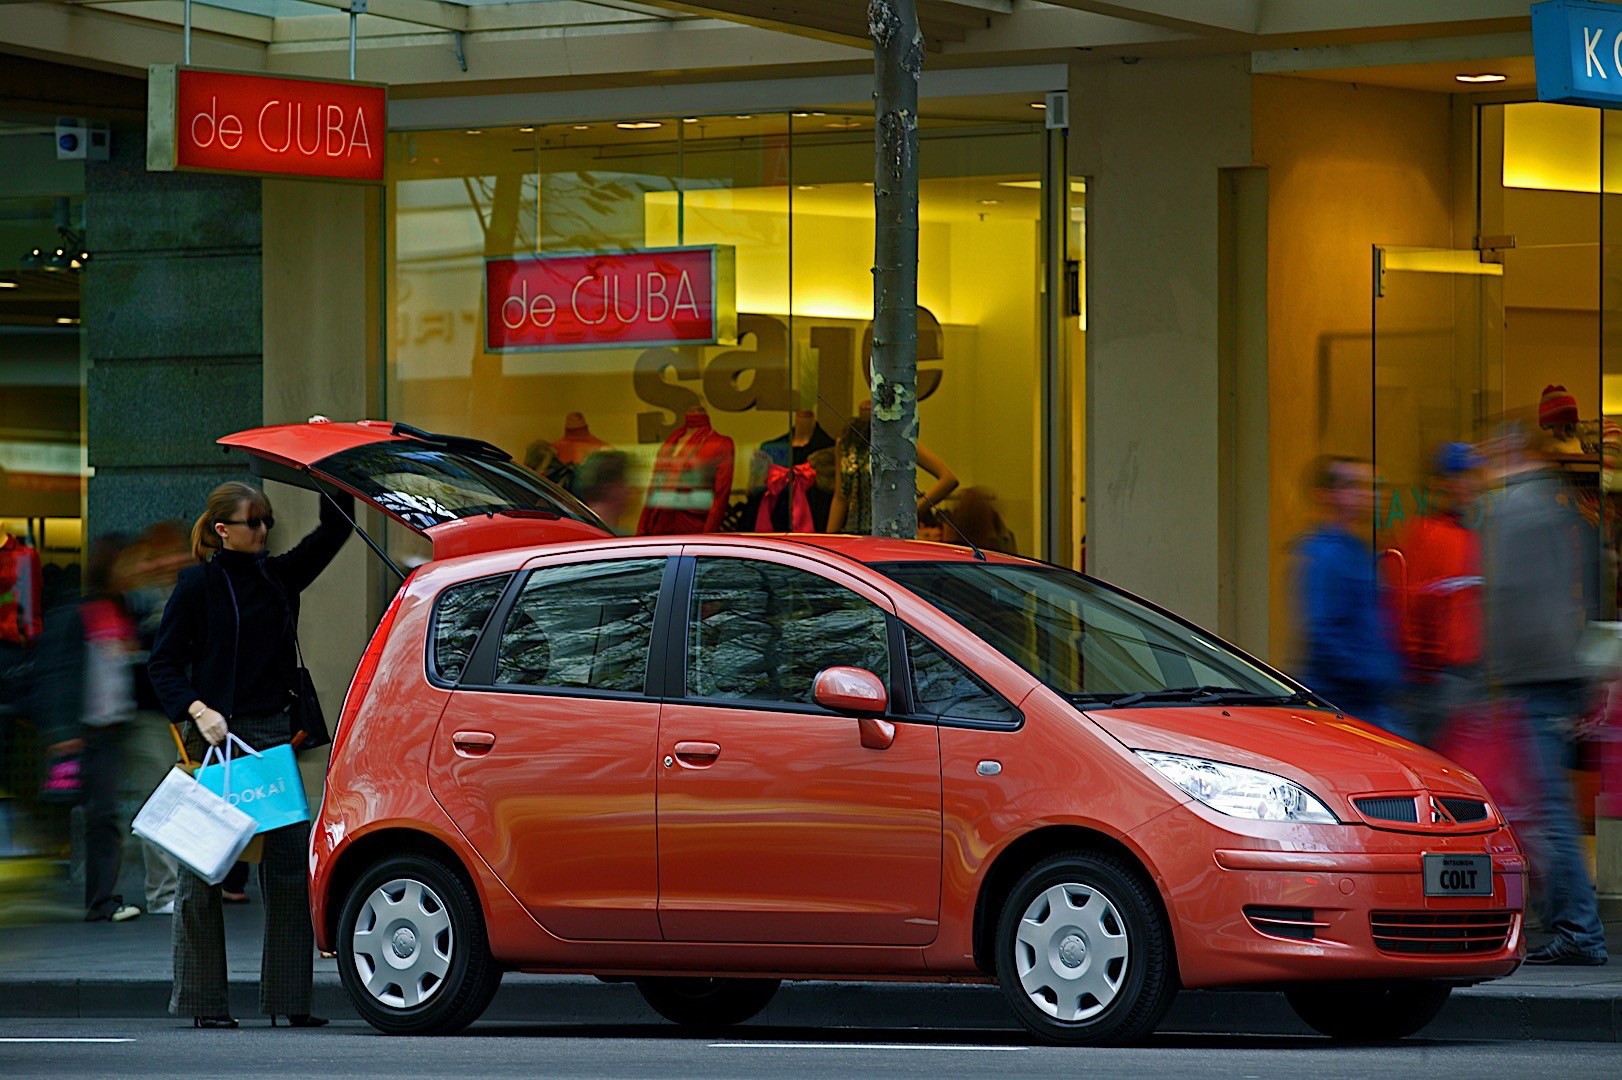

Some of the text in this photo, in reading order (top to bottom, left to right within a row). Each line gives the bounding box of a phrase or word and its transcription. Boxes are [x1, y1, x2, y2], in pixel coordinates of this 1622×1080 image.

[191, 96, 243, 150] de
[501, 279, 556, 329] de
[226, 777, 286, 806] OOKAÏ
[1440, 870, 1477, 889] COLT
